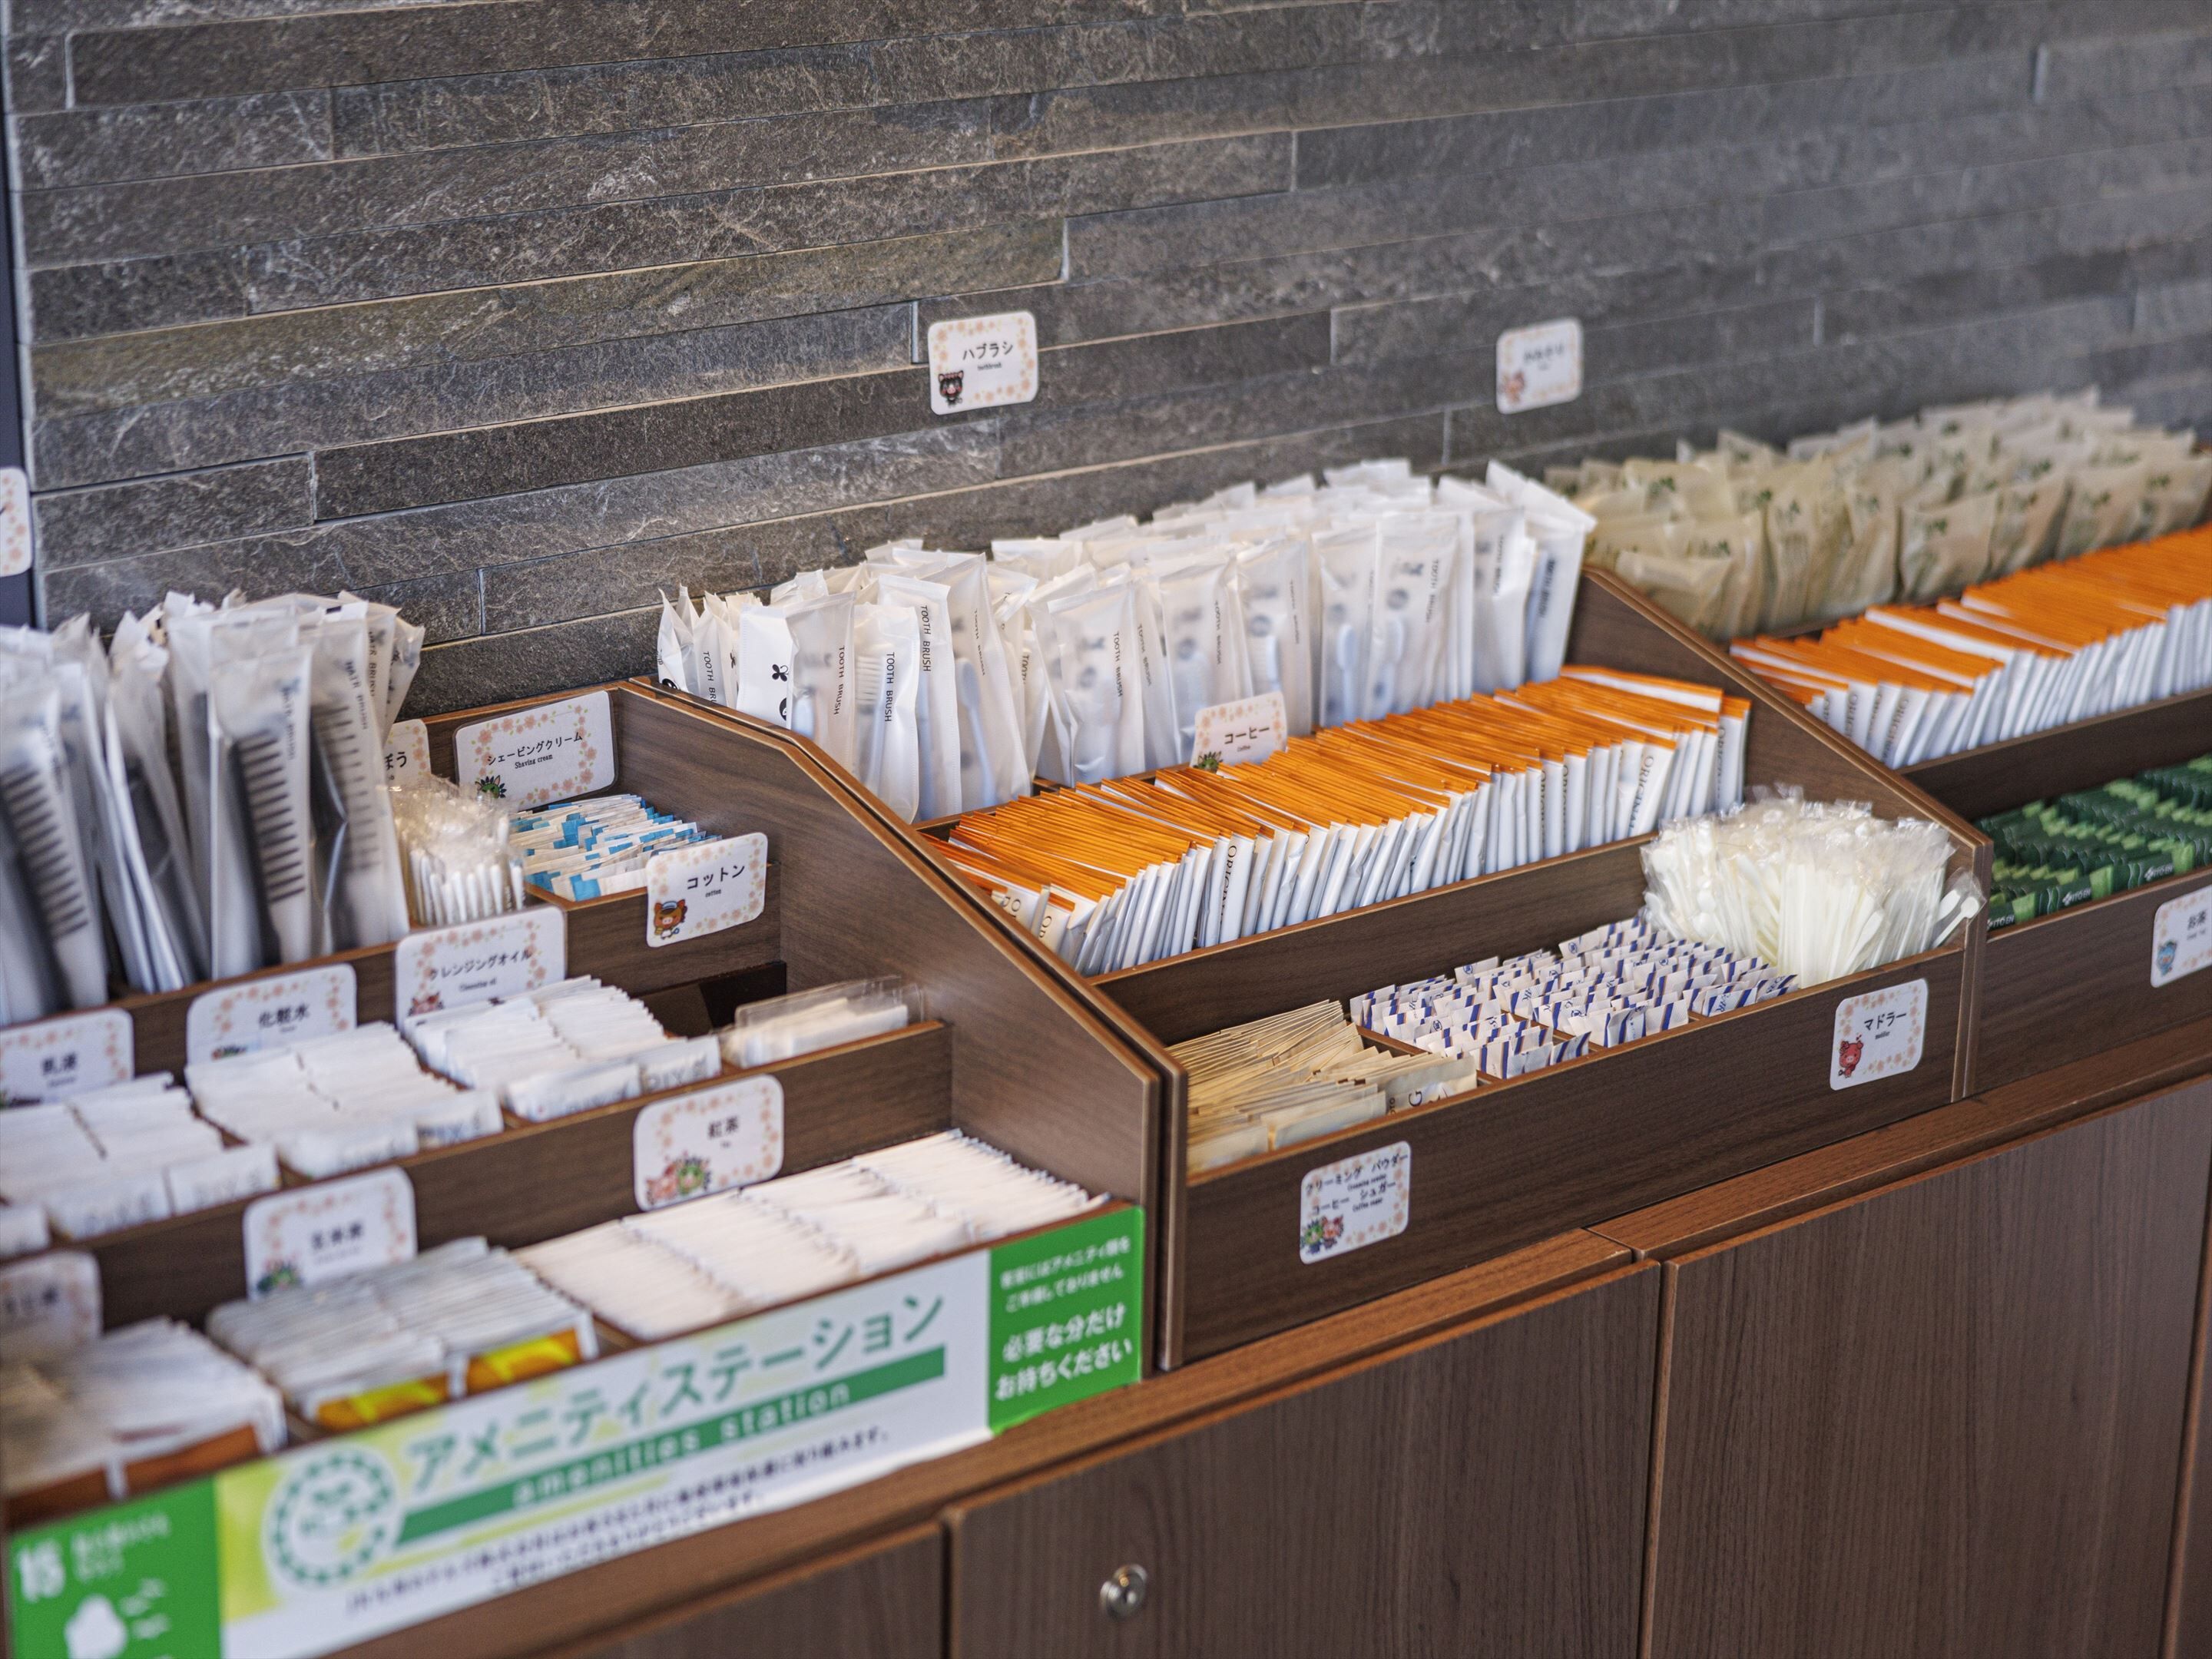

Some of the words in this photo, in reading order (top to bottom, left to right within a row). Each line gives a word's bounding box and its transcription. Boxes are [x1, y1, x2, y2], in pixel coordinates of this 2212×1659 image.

[962, 340, 1014, 361] ハブラシ
[920, 604, 931, 634] TOOTH
[703, 651, 714, 681] TOOTH
[885, 651, 896, 684] TOOTH
[922, 640, 931, 672] BRUSH
[833, 683, 844, 716] BRUSH
[884, 690, 894, 723] BRUSH
[487, 732, 583, 767] シェービングクリーム
[1224, 727, 1270, 745] コーヒー
[515, 756, 536, 770] Shaving
[538, 753, 554, 764] cream
[687, 865, 745, 890] コットン
[429, 949, 533, 981] クレンジングオイル
[258, 1002, 310, 1028] 化粧水
[1863, 1011, 1907, 1031] マドラー
[707, 1115, 740, 1140] 紅茶
[1306, 1165, 1362, 1194] クリーミング
[1372, 1153, 1409, 1173] パウダー
[1313, 1197, 1350, 1216] コーヒー
[1359, 1181, 1396, 1200] シュガー
[1002, 1301, 1127, 1363] 必要な分だけ
[994, 1337, 1134, 1402] お持ちください
[403, 1295, 944, 1495] アメニティステーション
[720, 1379, 853, 1442] station
